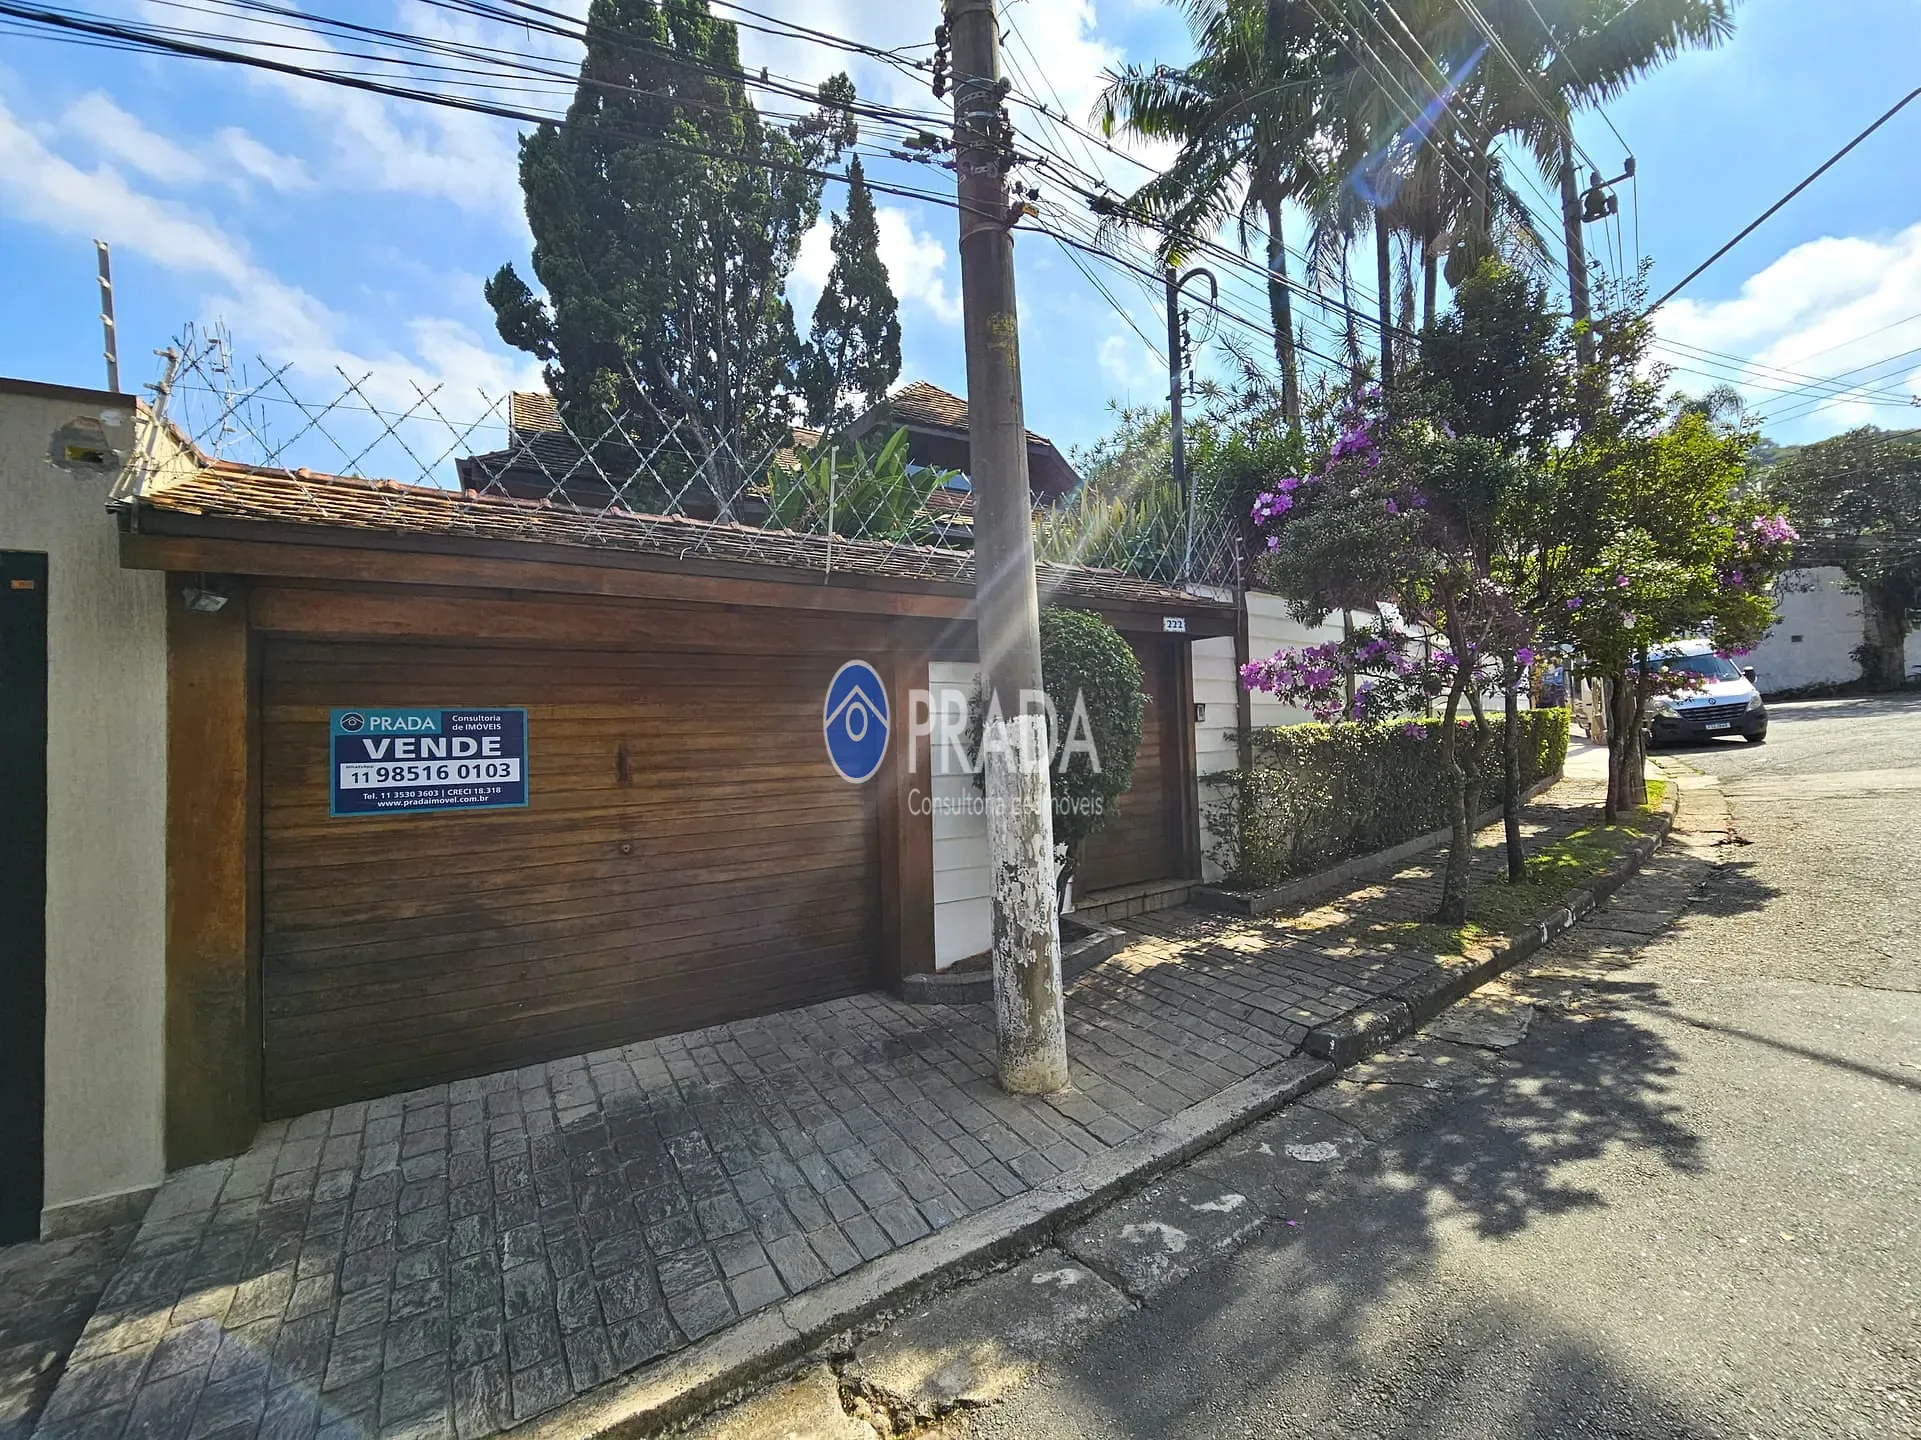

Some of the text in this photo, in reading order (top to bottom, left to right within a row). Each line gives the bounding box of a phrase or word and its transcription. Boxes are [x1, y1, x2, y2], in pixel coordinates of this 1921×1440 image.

[1167, 620, 1183, 629] 222
[370, 716, 436, 731] PRADA
[452, 714, 501, 723] Consultoria
[452, 721, 501, 731] de IMÓVEIS
[362, 736, 501, 760] VENDE
[352, 762, 511, 784] 11 98516 0103
[363, 792, 378, 800] Tel.
[393, 791, 416, 799] 3530
[417, 789, 439, 797] 3603
[447, 788, 472, 796] CRECI
[474, 786, 501, 795] 18.318
[377, 795, 489, 808] www.pradaimovel.com.br
